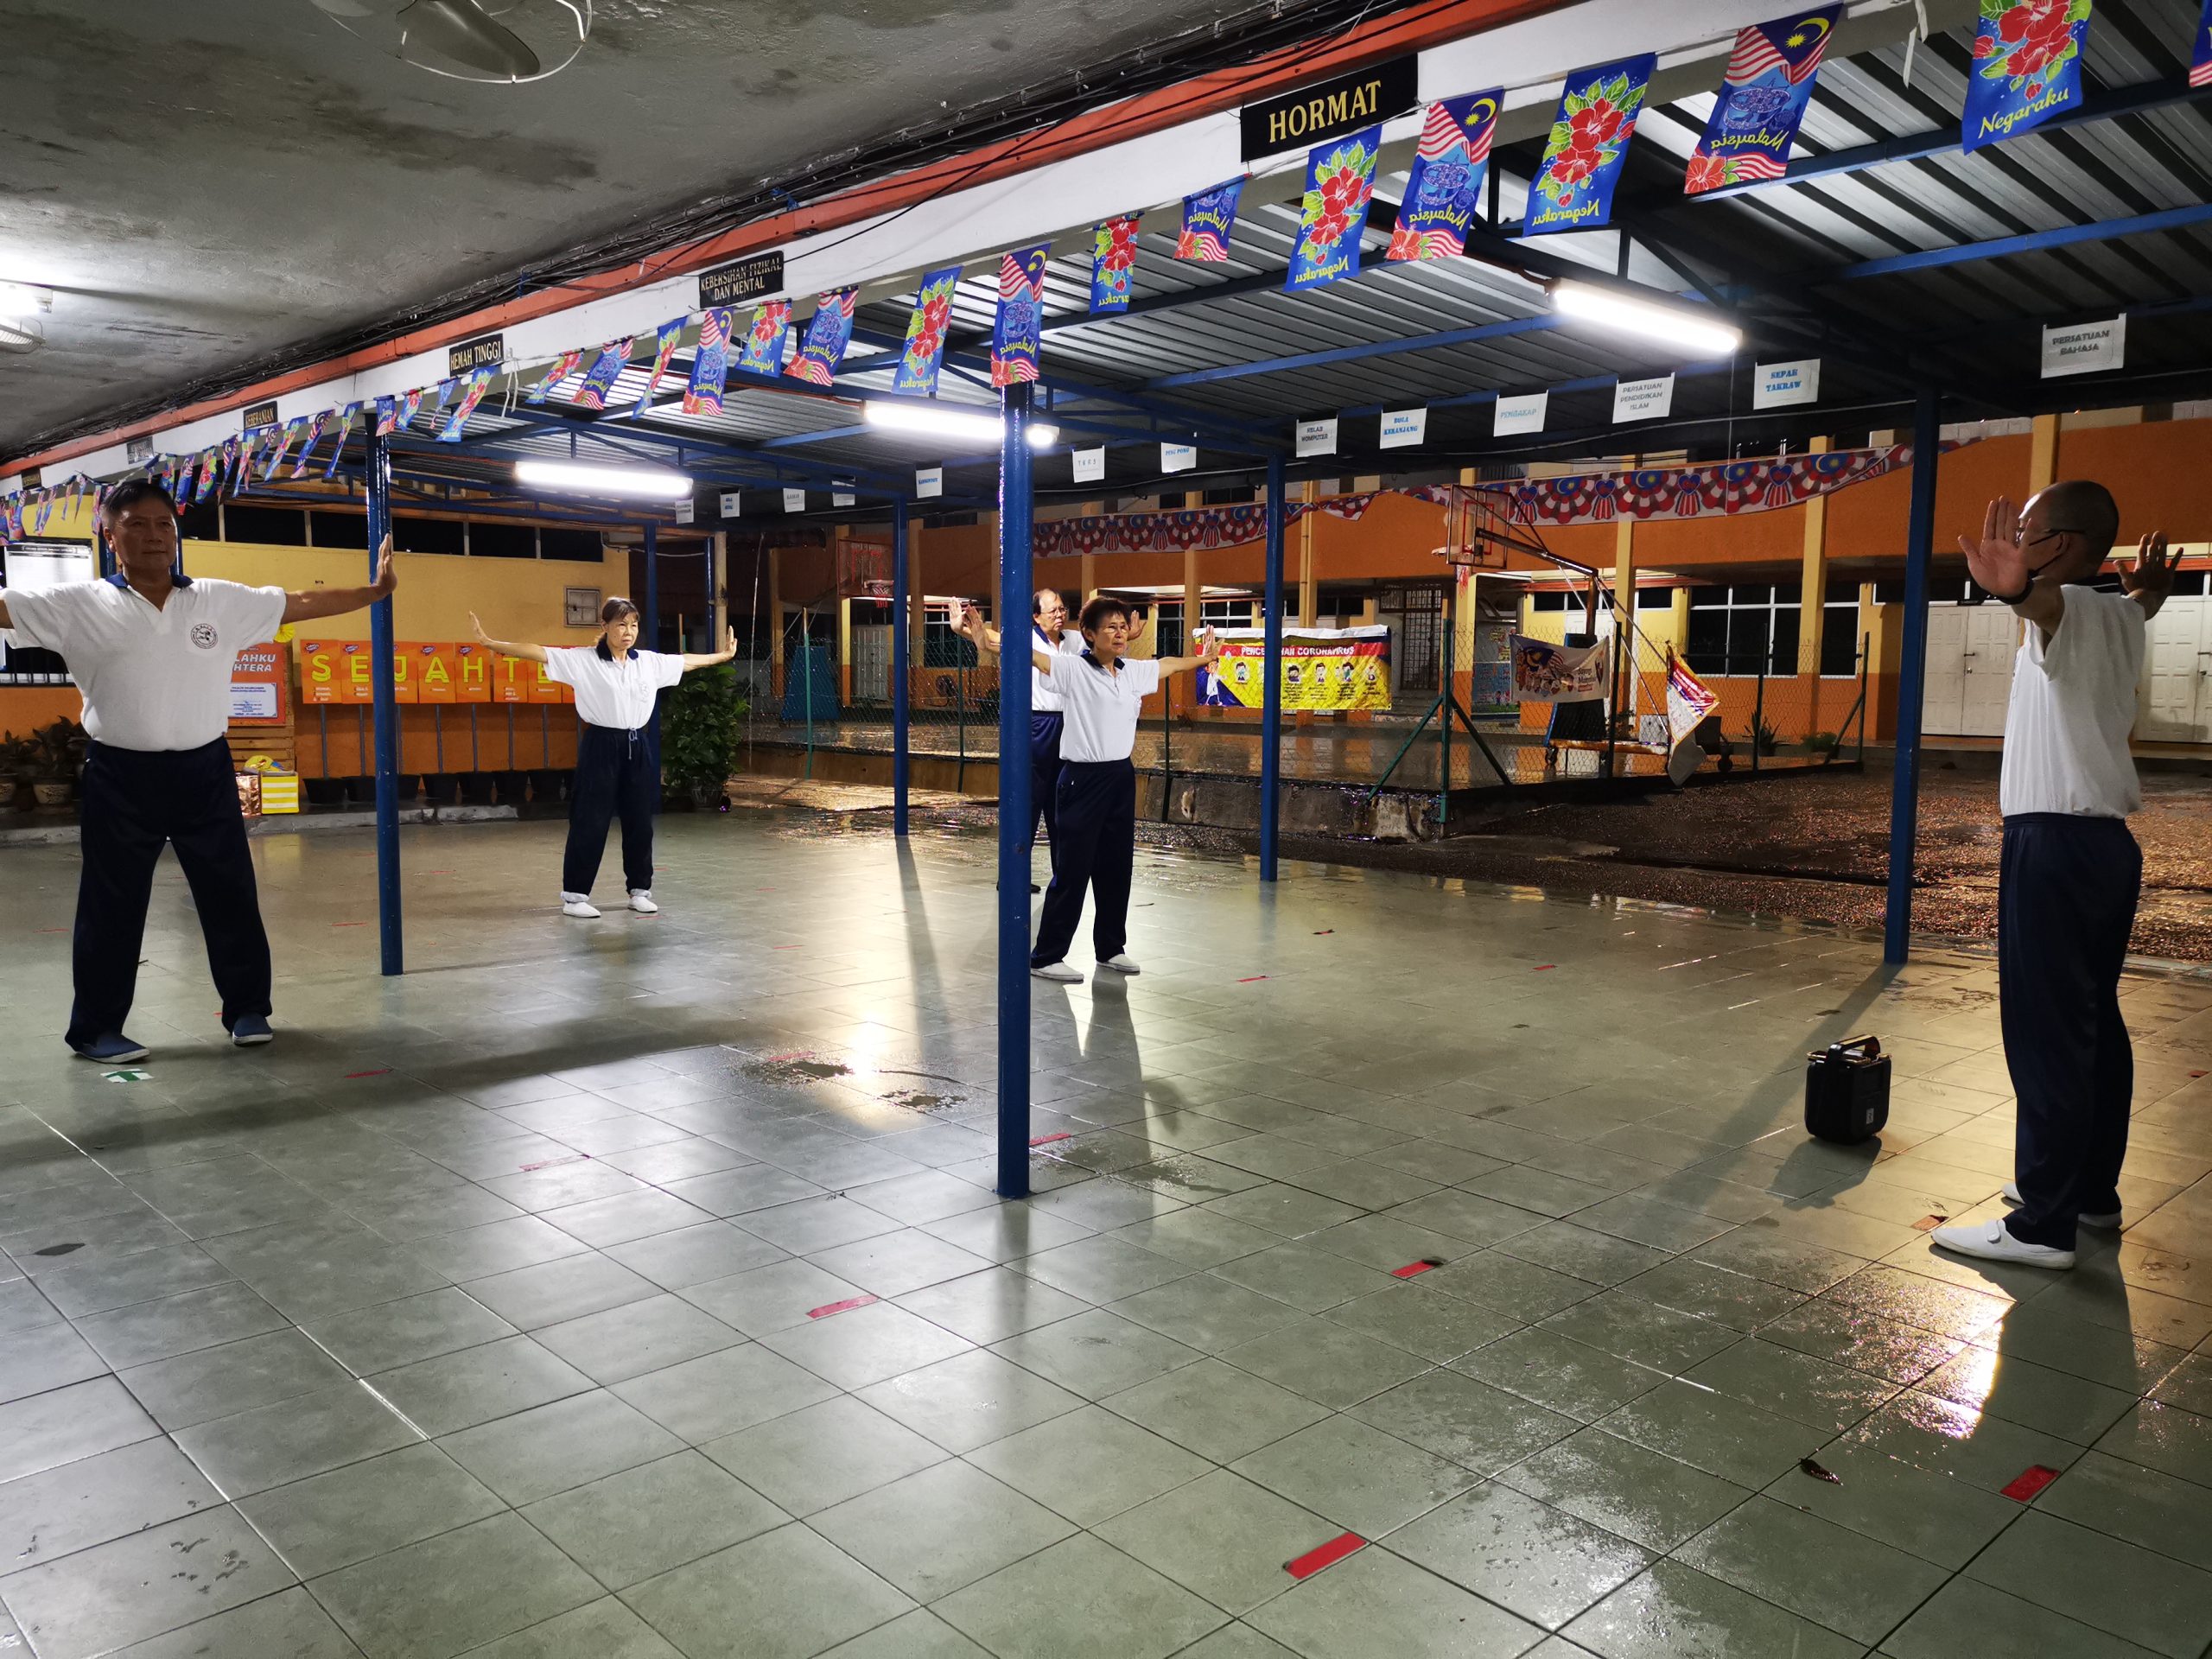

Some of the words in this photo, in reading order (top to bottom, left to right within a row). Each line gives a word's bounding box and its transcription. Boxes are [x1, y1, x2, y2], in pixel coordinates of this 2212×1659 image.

[1269, 79, 1381, 143] HORMAT
[1978, 87, 2069, 139] Negaraku
[701, 265, 747, 291] KEBERSIHAN
[749, 257, 782, 276] FIZIKAL
[715, 284, 730, 301] DAN
[733, 276, 765, 296] MENTAL
[2052, 329, 2110, 345] PERSATUAN
[450, 348, 473, 372] HEMAH
[474, 340, 501, 363] TINGGI
[2060, 343, 2100, 356] BAHASA
[1770, 369, 1798, 379] SEPAK
[1622, 382, 1663, 393] PERSATUAN
[1765, 380, 1802, 392] TAKRAW
[1620, 391, 1663, 403] PENDIDIKAN
[1630, 402, 1649, 410] ISLAM
[1298, 645, 1355, 656] CORONAVIRUS
